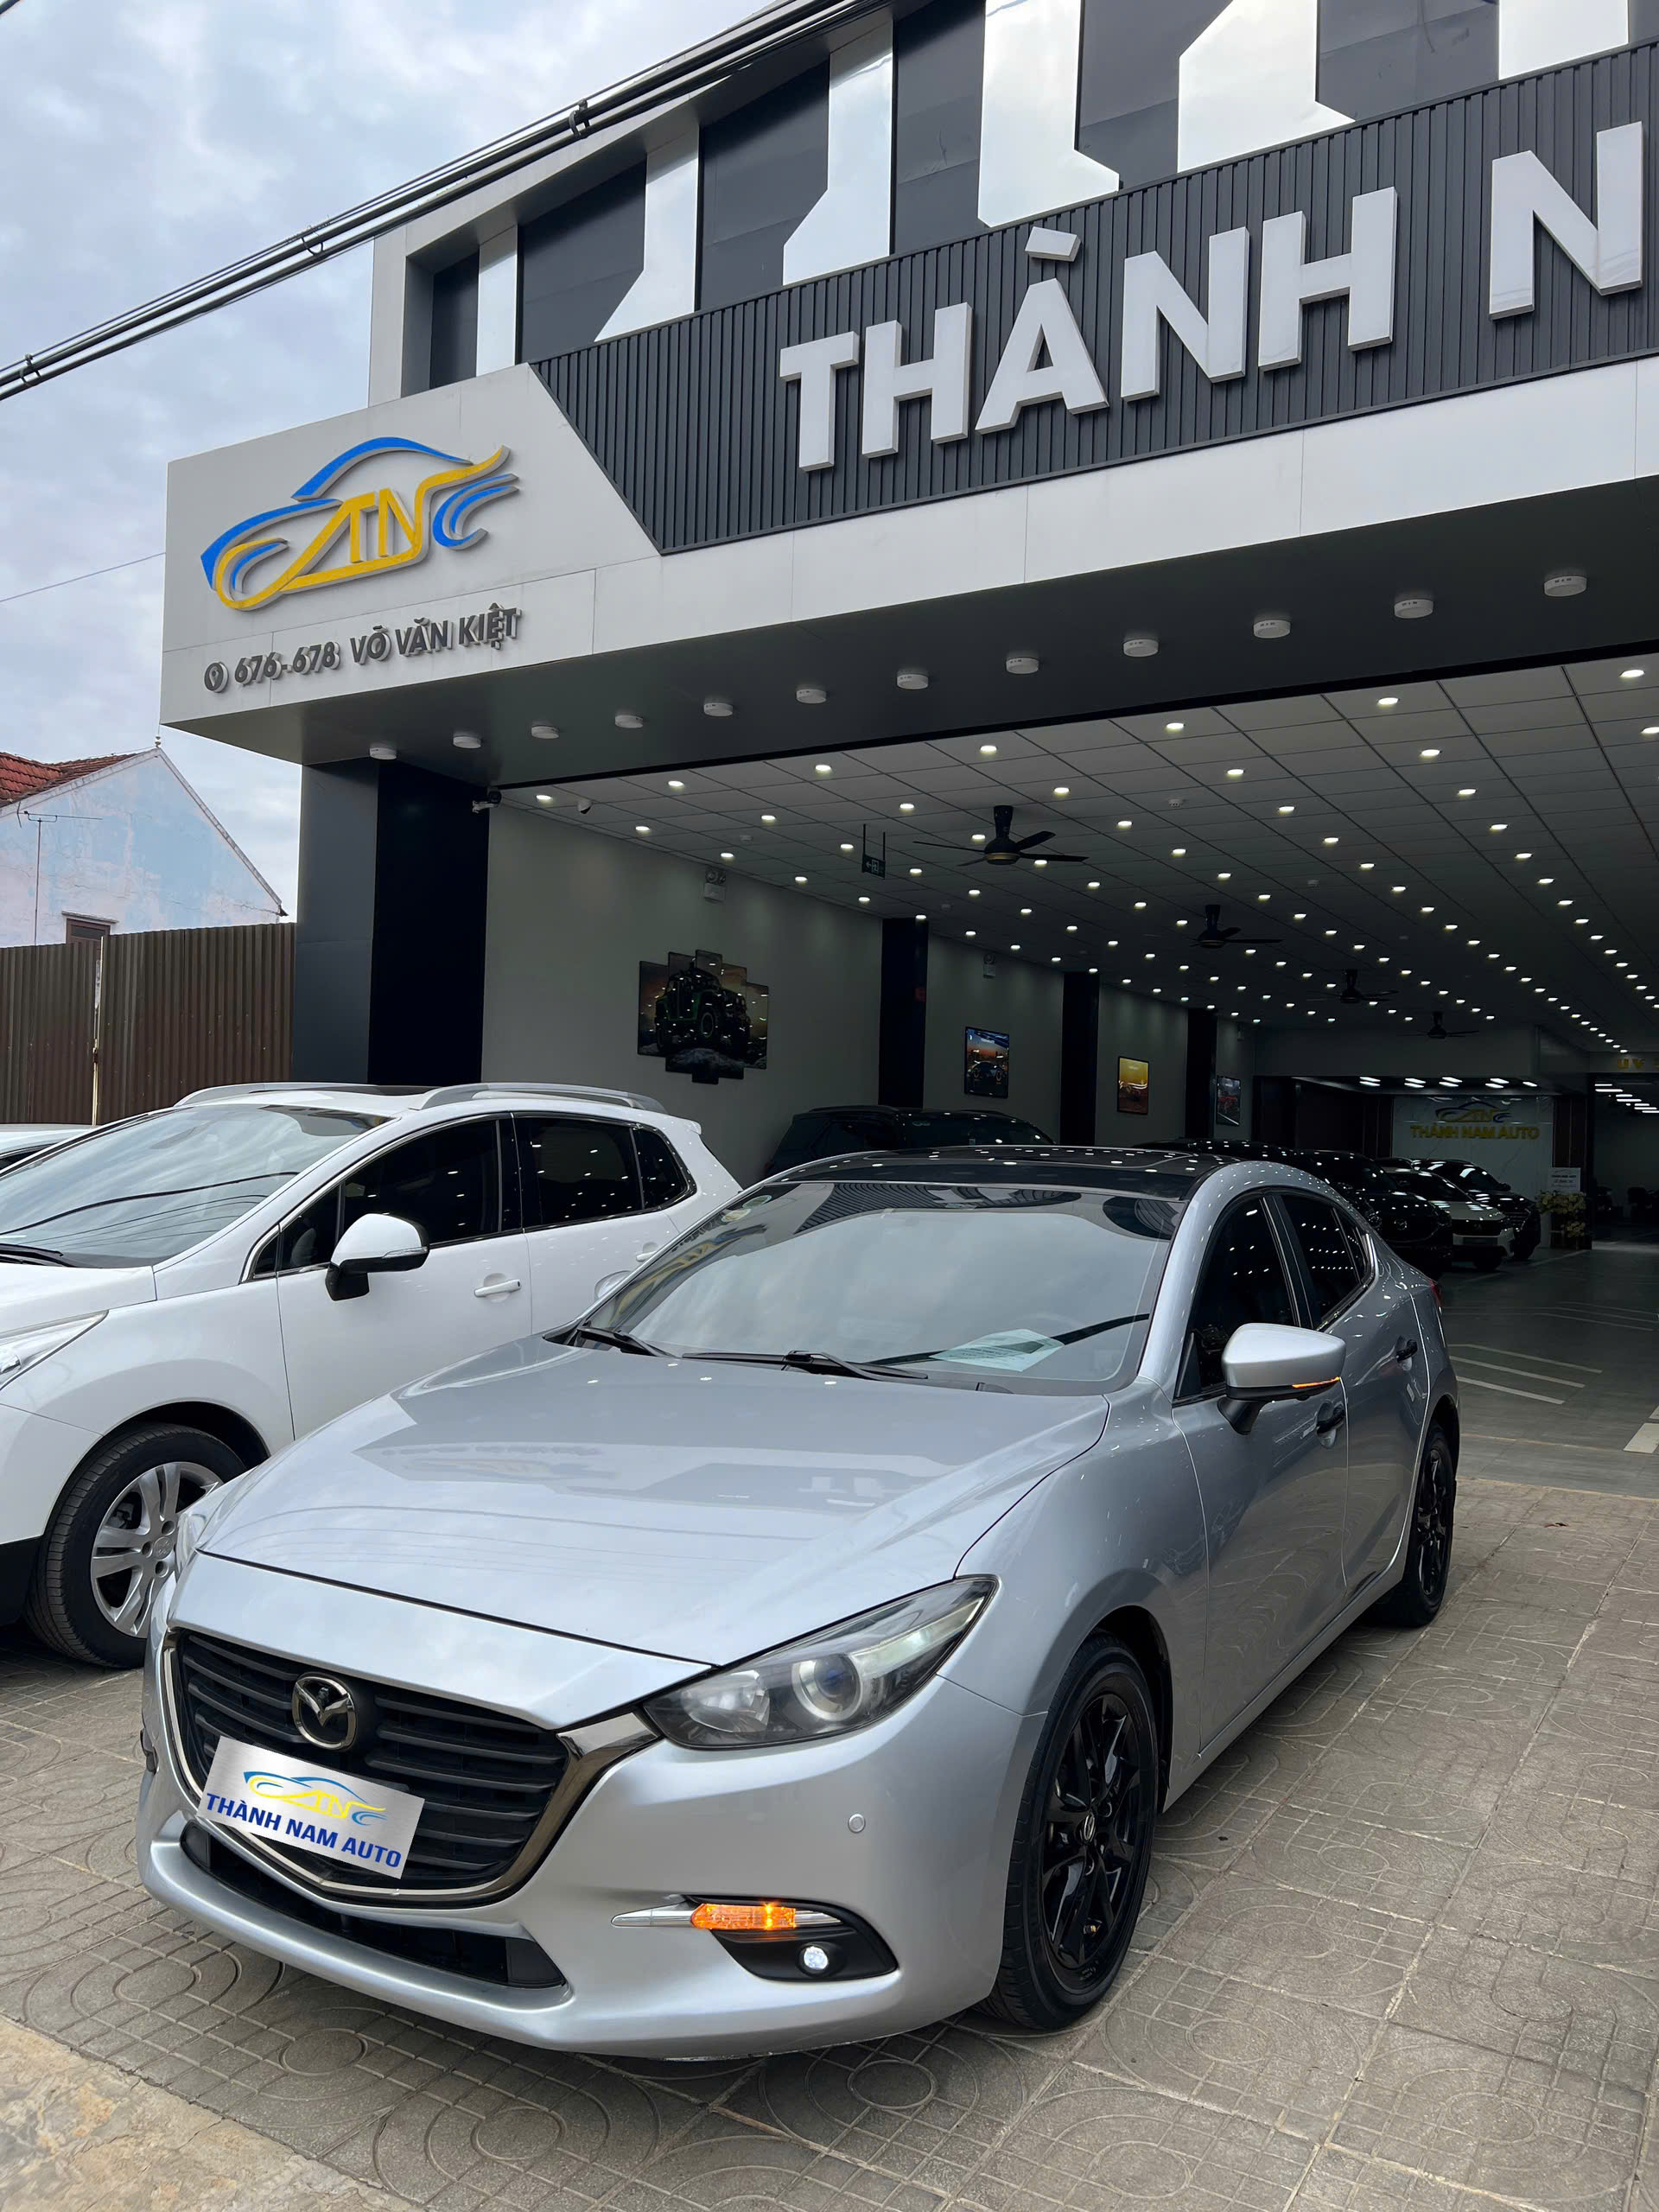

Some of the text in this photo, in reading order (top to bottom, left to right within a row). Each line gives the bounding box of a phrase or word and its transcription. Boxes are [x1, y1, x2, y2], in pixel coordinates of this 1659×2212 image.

[779, 187, 1398, 474] THÀNH
[235, 602, 523, 685] 676-678 VÕ VĂN KIỆT
[207, 1793, 402, 1868] THÀNH NAM AUTO
